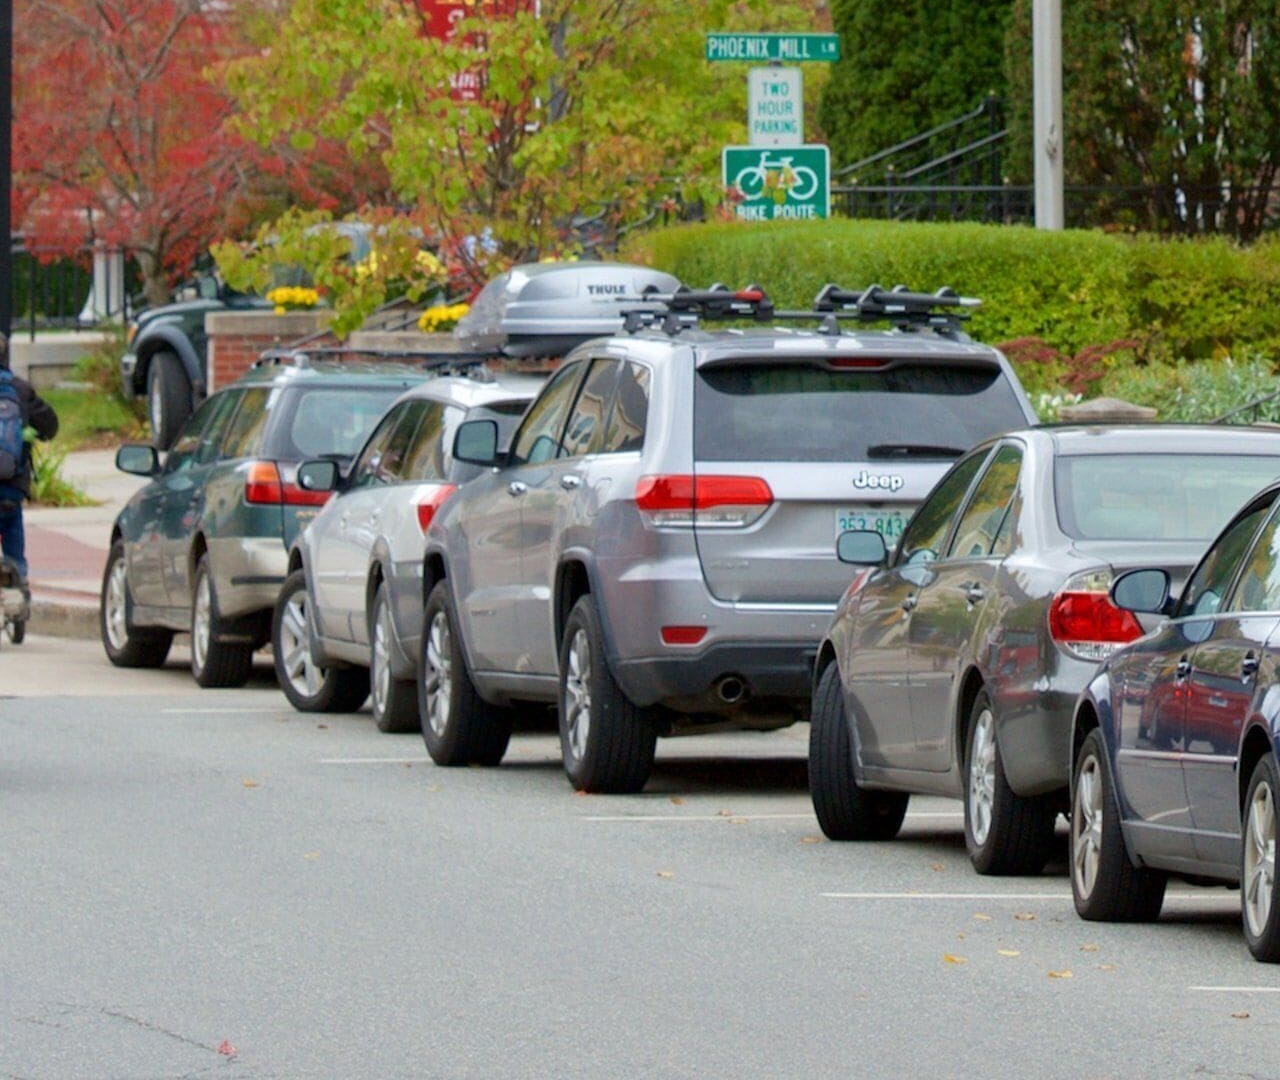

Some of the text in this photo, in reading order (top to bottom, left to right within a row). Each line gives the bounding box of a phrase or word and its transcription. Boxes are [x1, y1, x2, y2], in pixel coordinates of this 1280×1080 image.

[708, 37, 836, 58] PHOENIX MILL LN
[762, 81, 789, 97] TWO
[758, 100, 793, 116] HOUR
[754, 119, 798, 135] PARKING
[736, 204, 817, 221] BIKE ROUTE
[587, 285, 626, 294] THULE
[853, 471, 904, 492] Jeep
